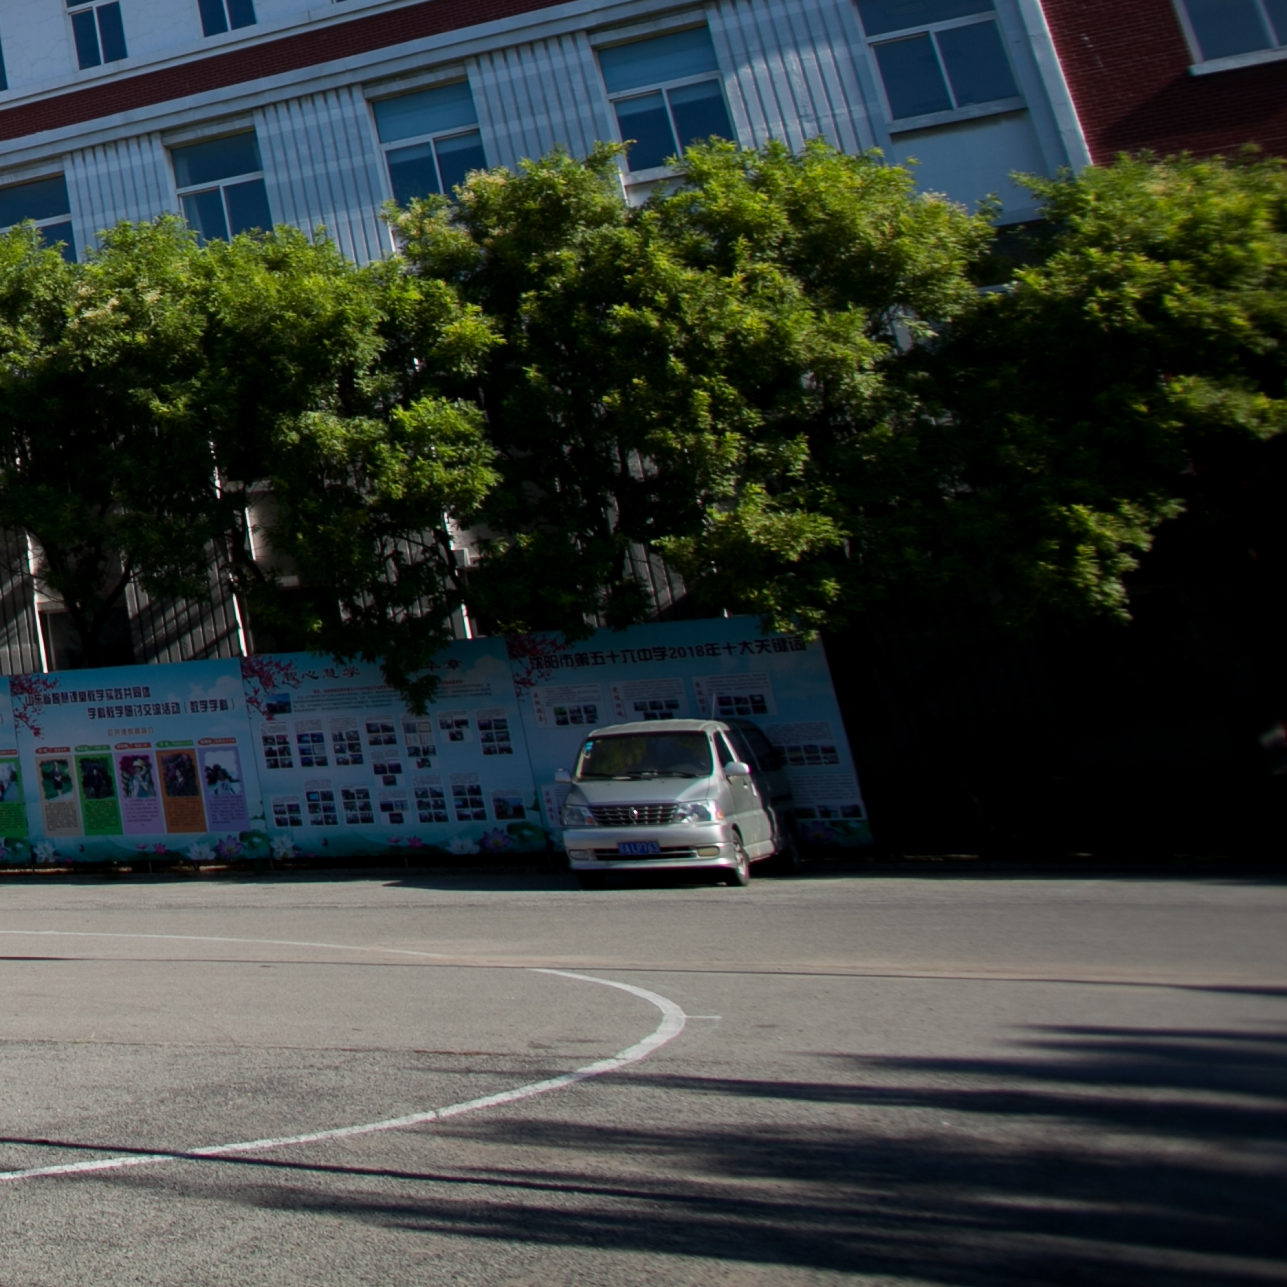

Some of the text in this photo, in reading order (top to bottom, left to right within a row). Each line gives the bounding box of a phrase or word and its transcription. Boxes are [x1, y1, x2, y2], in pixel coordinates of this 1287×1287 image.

[25, 686, 151, 707] 山东省智慧课堂教学实践共同体
